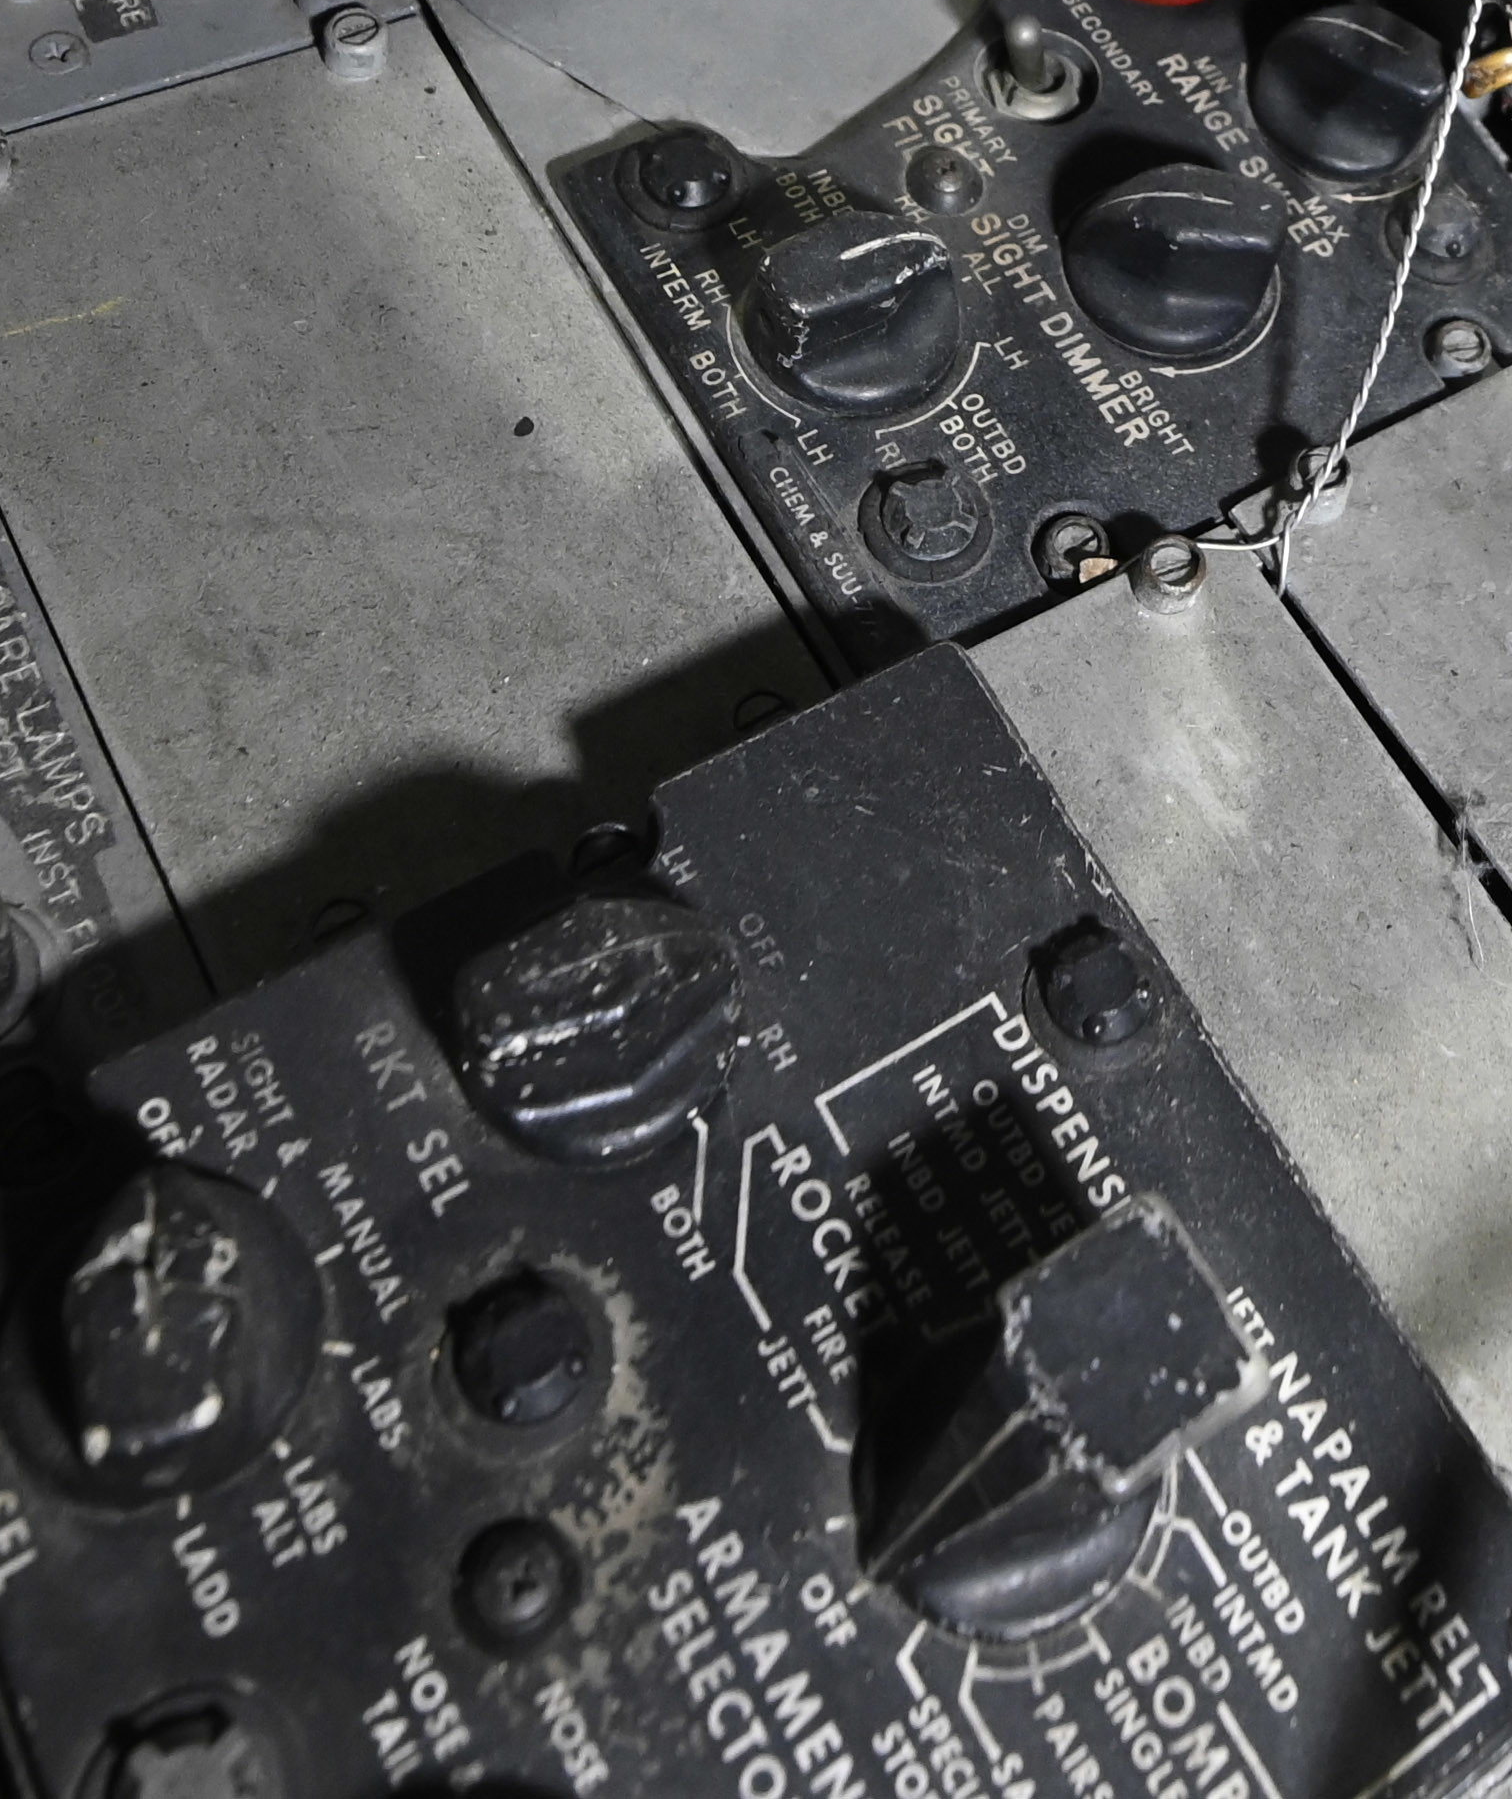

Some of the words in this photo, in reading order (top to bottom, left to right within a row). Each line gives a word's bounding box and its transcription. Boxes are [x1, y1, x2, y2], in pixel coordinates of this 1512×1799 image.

[1155, 52, 1251, 153] RANGE
[1192, 54, 1235, 95] MIN
[912, 94, 996, 178] SIGHT
[944, 75, 1018, 167] PRIMARY
[728, 215, 763, 250] LH
[775, 169, 824, 226] BOTH
[1005, 212, 1050, 257] DIM
[1302, 195, 1352, 244] MAX
[639, 242, 712, 334] INTERM
[693, 266, 733, 307] RH
[959, 250, 1003, 297] ALL
[970, 212, 1058, 307] SIGHT
[1039, 309, 1153, 450] DIMMER
[992, 332, 1032, 372] LH
[688, 350, 747, 422] BOTH
[1118, 369, 1195, 458] BRIGHT
[796, 426, 835, 469] LH
[938, 412, 1000, 486] BOTH
[959, 390, 1028, 477] OUTBD
[768, 464, 813, 530] CHEM
[809, 530, 830, 550] &
[16, 700, 109, 847] LAMPS
[21, 831, 82, 905] INST
[659, 844, 698, 888] LH
[737, 911, 788, 972] OFF
[755, 1021, 800, 1074] RH
[136, 1095, 189, 1158] OFF
[186, 1033, 260, 1158] RADAR
[230, 1031, 295, 1128] SIGHT
[275, 1136, 313, 1168] &
[353, 1021, 429, 1113] RKT
[405, 1126, 472, 1219] SEL
[971, 1077, 1047, 1191] OUTBD
[992, 1013, 1136, 1213] DISPENS
[911, 1062, 989, 1174] INTMD
[980, 1185, 1039, 1261] JETT
[316, 1160, 412, 1325] MANUAL
[649, 1181, 717, 1282] BOTH
[768, 1142, 900, 1338] ROCKET
[843, 1169, 934, 1309] RELEASE
[886, 1129, 948, 1215] INBD
[934, 1223, 992, 1292] JETT
[756, 1333, 819, 1411] JETT
[802, 1301, 859, 1386] FIRE
[279, 1453, 350, 1558] LABS
[1268, 1350, 1421, 1586] NAPALM
[249, 1496, 309, 1571] ALT
[1221, 1508, 1306, 1634] OUTBD
[1244, 1418, 1285, 1467] &
[1275, 1456, 1384, 1621] TANK
[1364, 1624, 1456, 1732] JETT
[170, 1520, 241, 1641] LADD
[799, 1571, 861, 1651] OFF
[1165, 1592, 1233, 1695] INBD
[1212, 1580, 1300, 1714] INTMD
[392, 1632, 473, 1765] NOSE
[533, 1678, 611, 1799] NOSE
